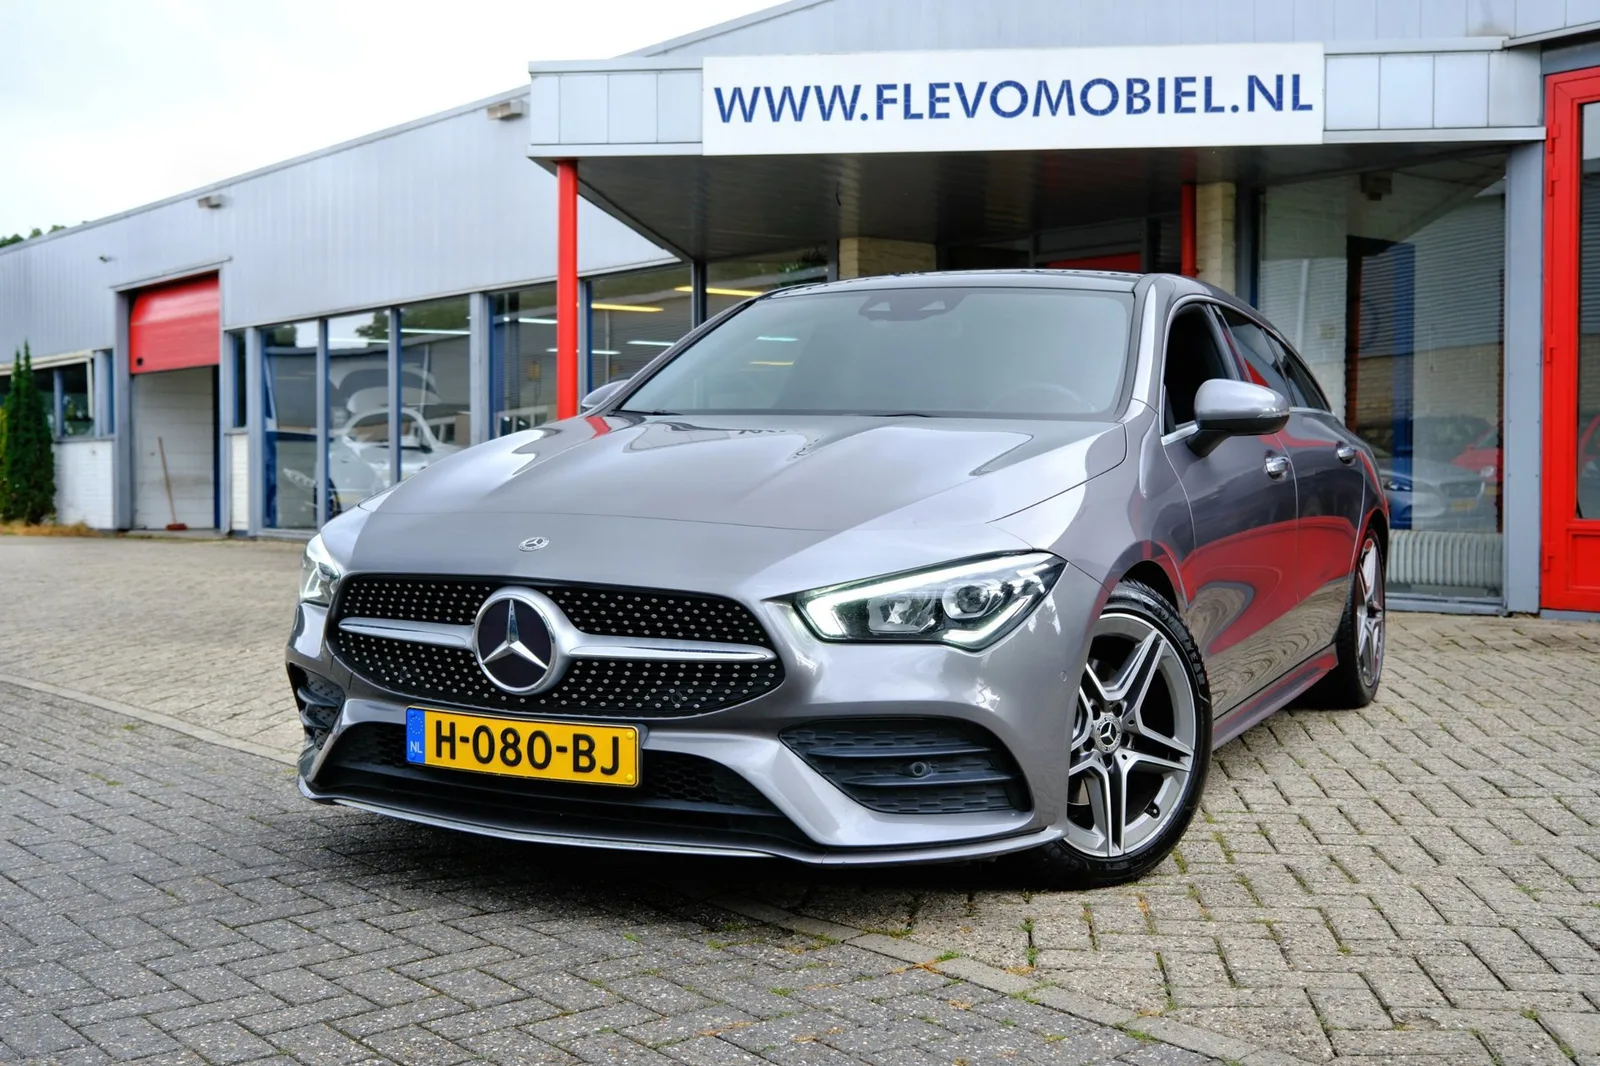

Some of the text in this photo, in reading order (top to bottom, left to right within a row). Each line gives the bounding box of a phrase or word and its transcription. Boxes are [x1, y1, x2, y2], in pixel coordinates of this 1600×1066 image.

[714, 74, 1312, 123] WWW.FLEVOMOBIEL.NL
[410, 740, 424, 754] NL
[435, 720, 620, 776] H-080-BJ
